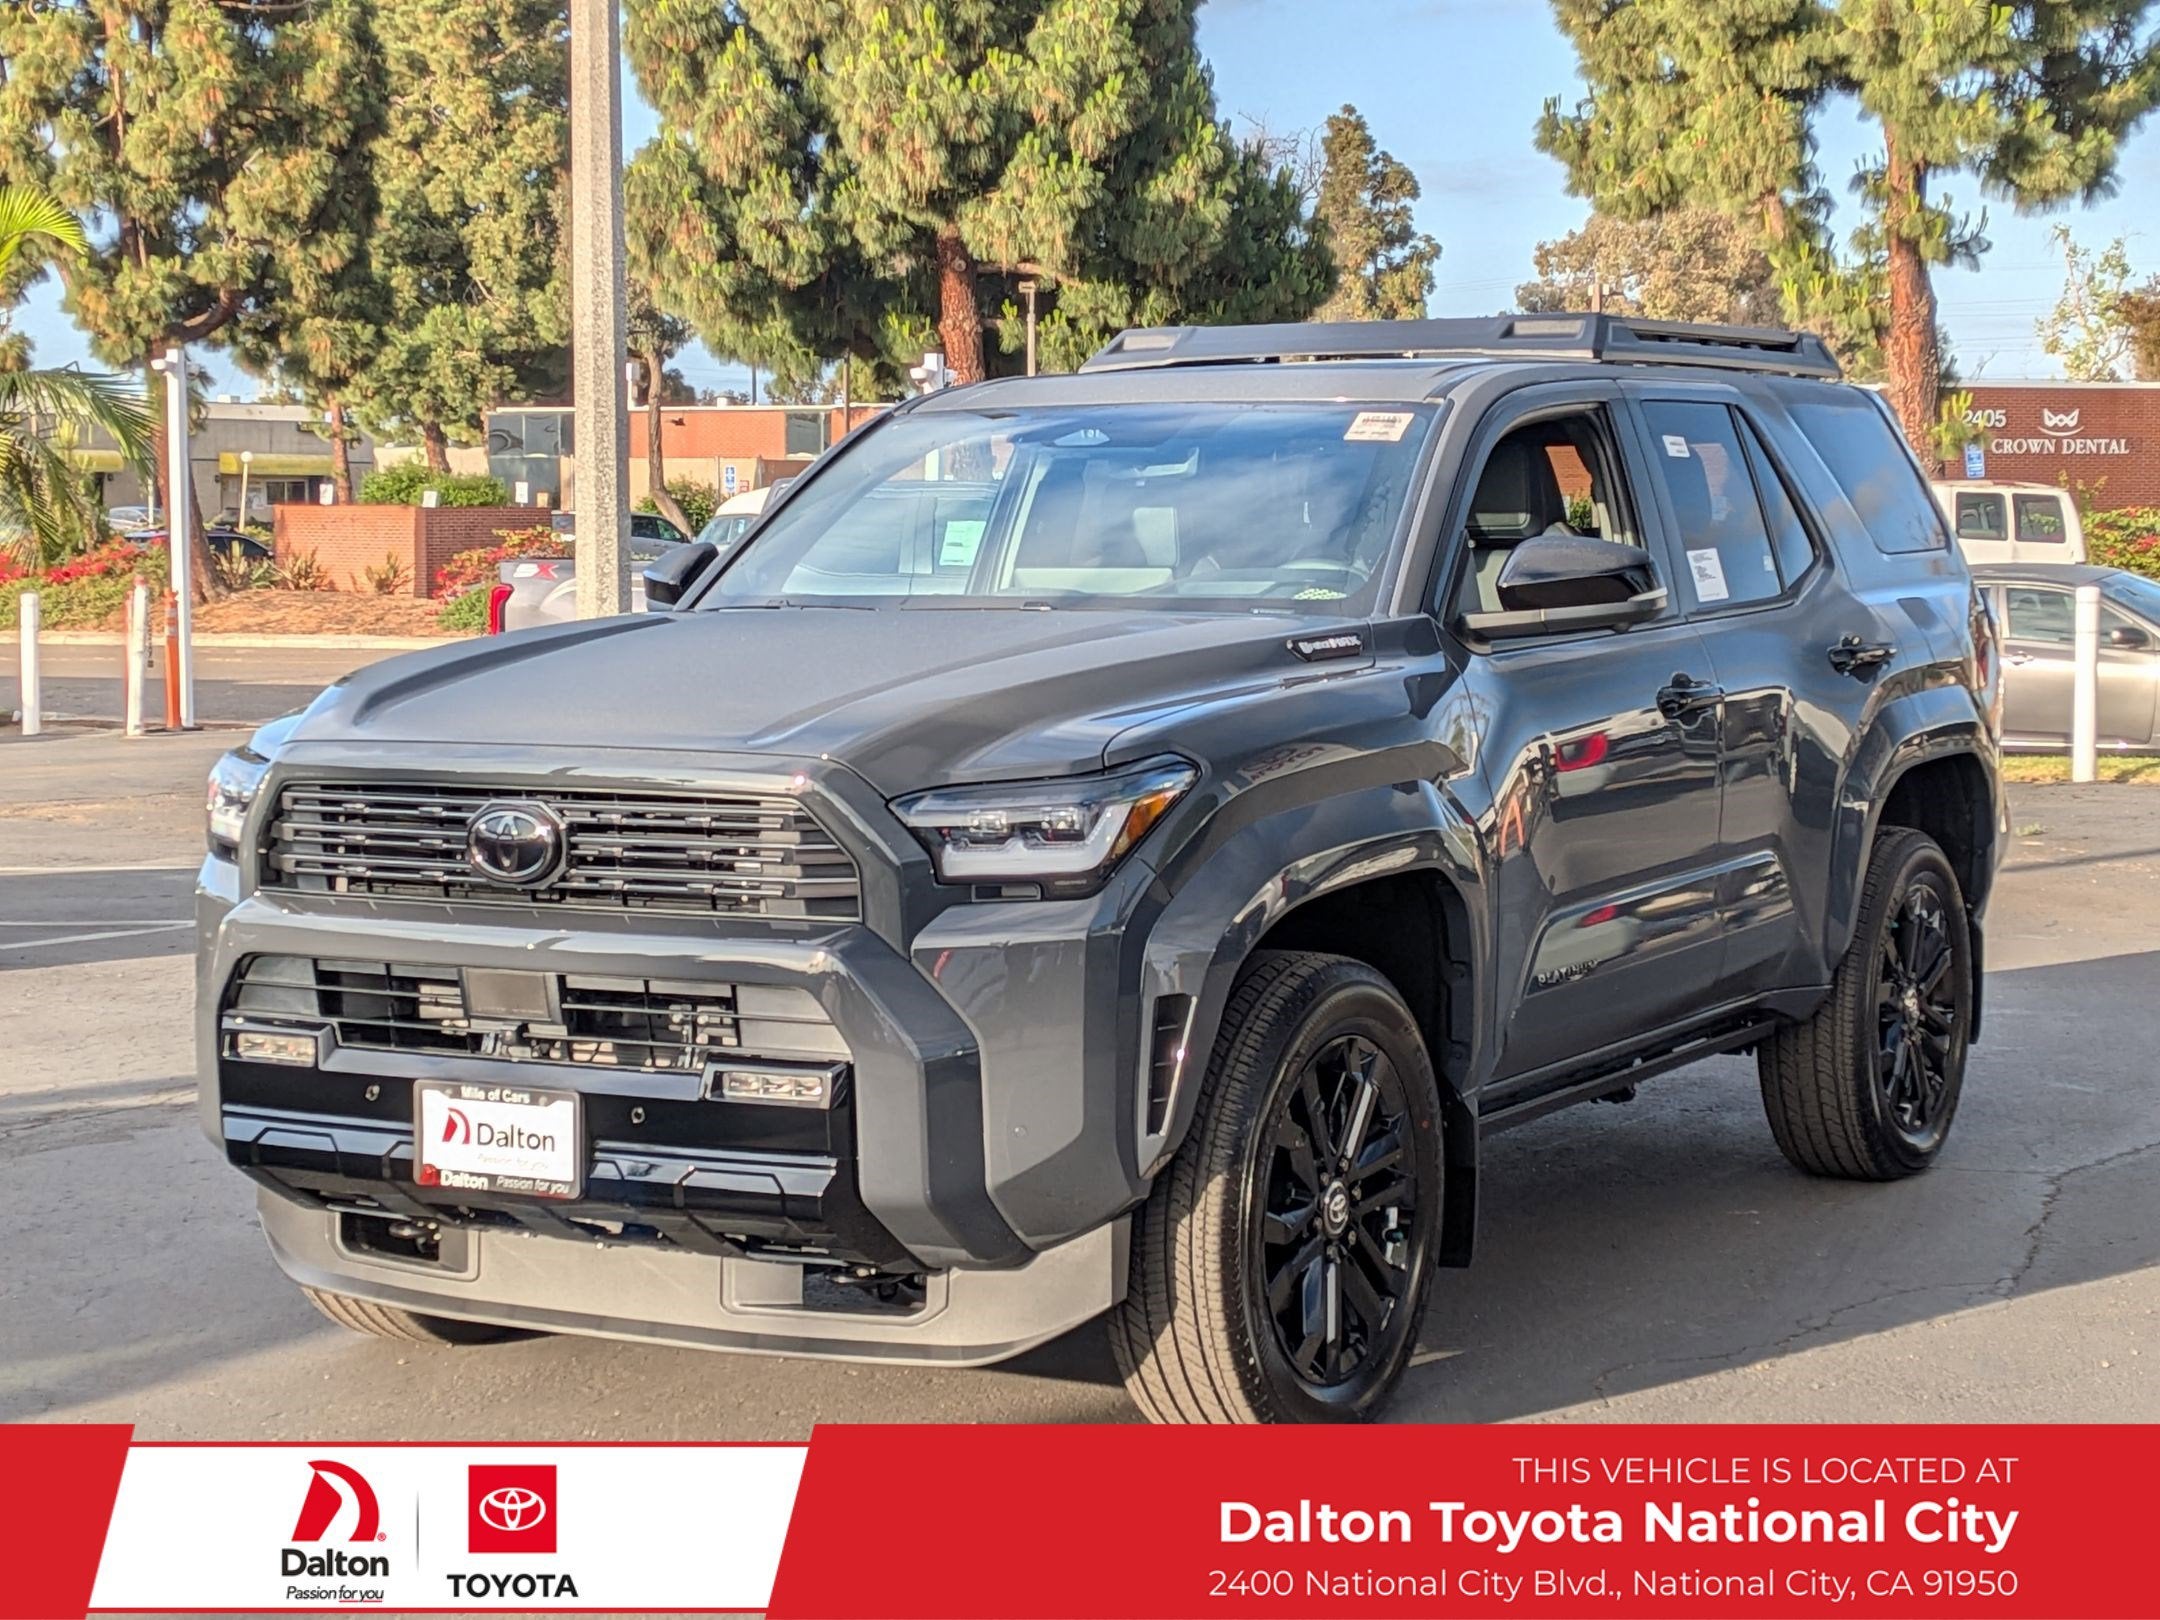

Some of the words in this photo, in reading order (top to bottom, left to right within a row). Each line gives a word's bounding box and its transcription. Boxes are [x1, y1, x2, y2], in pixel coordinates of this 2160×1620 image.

[1962, 409, 2007, 428] 2405
[1991, 438, 2056, 455] CROWN
[2061, 438, 2130, 455] DENTAL
[488, 1088, 500, 1101] of
[502, 1088, 531, 1104] Cars
[477, 1123, 556, 1151] Dalton
[440, 1169, 488, 1190] Dalton
[496, 1175, 533, 1190] Passion
[535, 1179, 549, 1191] for
[550, 1181, 570, 1195] you
